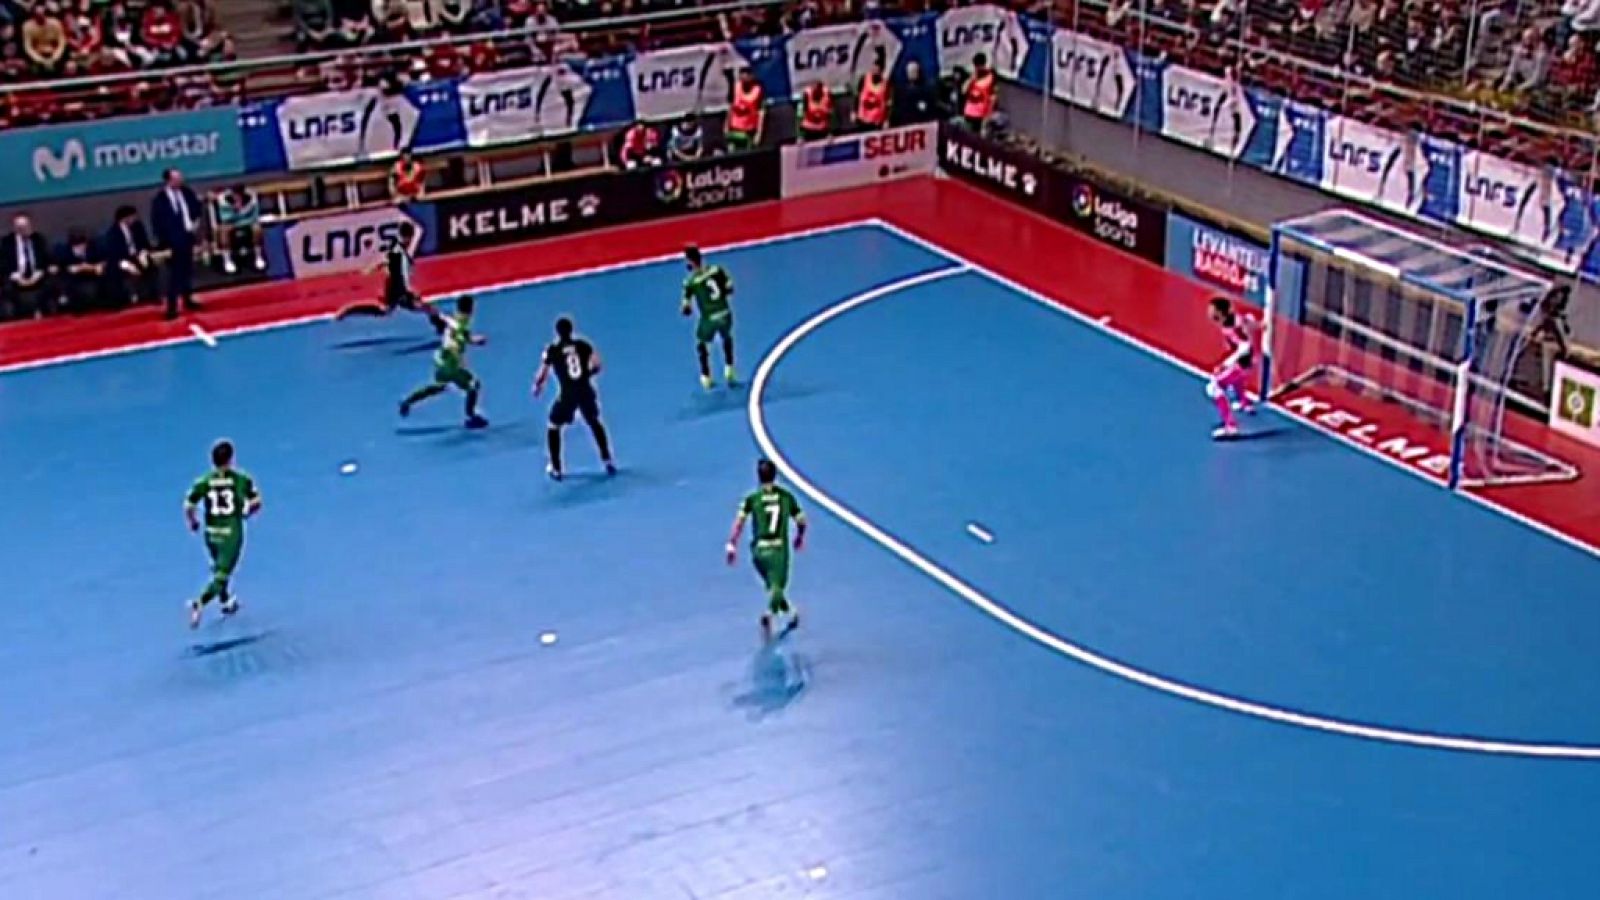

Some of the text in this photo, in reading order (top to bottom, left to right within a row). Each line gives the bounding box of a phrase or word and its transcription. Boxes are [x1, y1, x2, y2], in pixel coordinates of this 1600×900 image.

[93, 131, 220, 168] movistar
[863, 130, 925, 158] SEUR
[944, 140, 1017, 187] KELME
[449, 199, 569, 238] KELME
[709, 280, 721, 300] 3
[566, 355, 582, 378] 8
[207, 490, 235, 515] 13
[765, 505, 780, 532] 7
